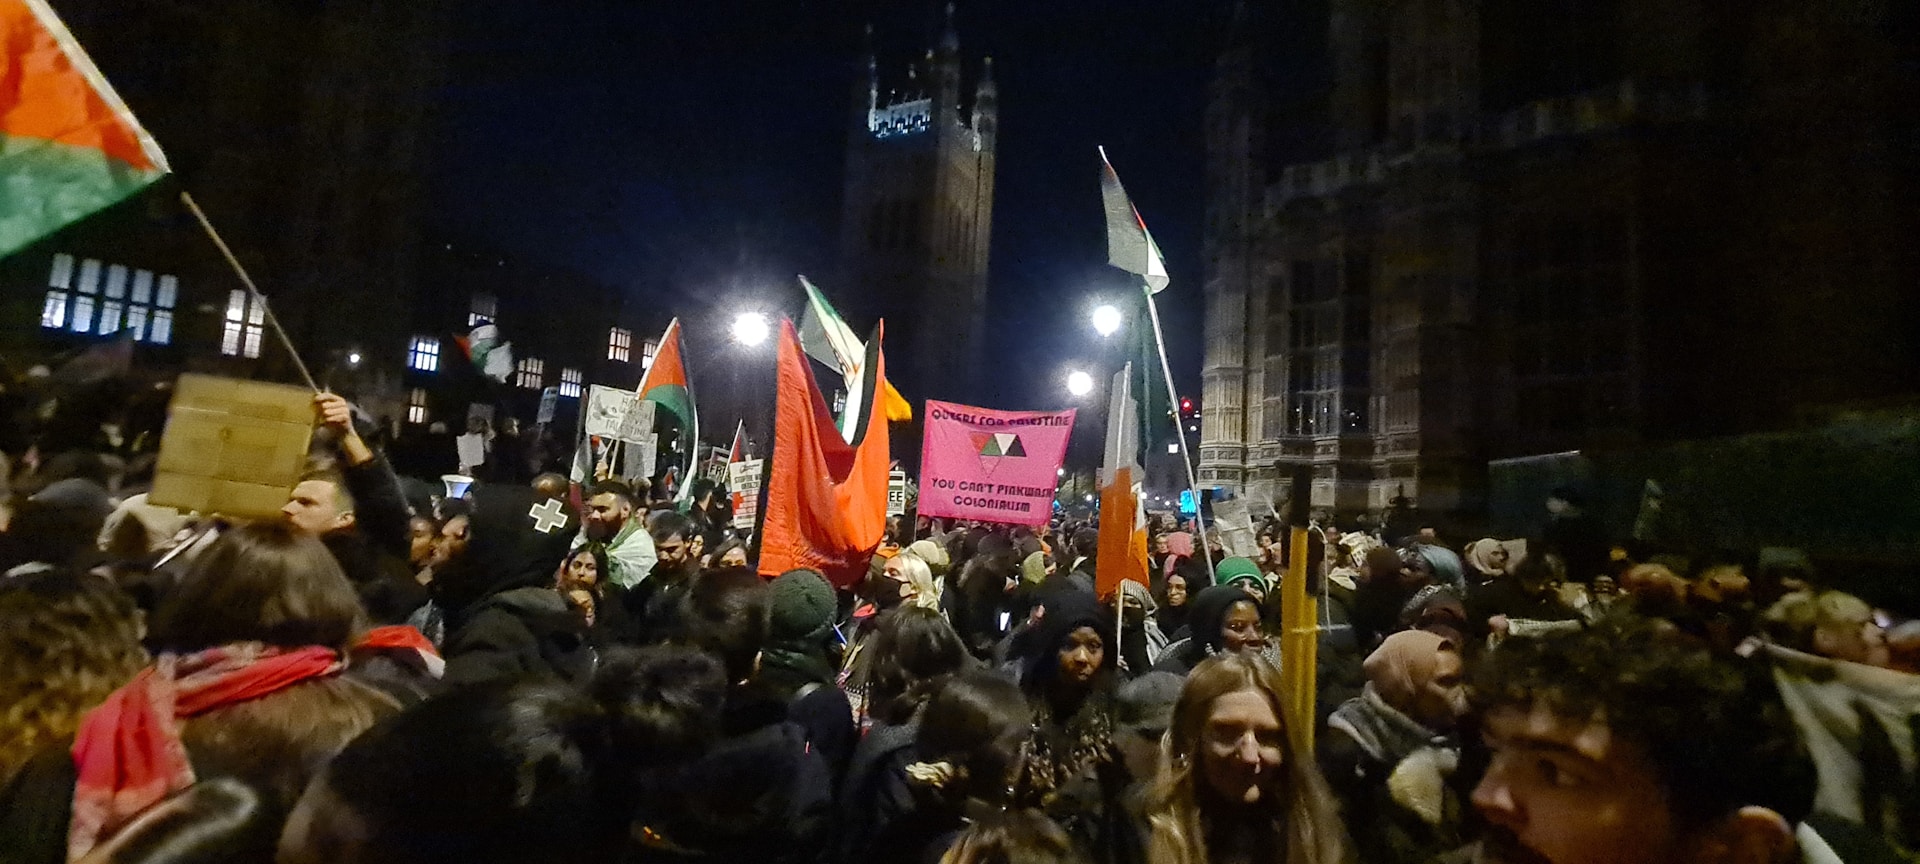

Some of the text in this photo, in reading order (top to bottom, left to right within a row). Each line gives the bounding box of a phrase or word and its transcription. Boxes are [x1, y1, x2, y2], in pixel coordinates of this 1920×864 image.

[931, 409, 1071, 427] QUEERS FOR PALESTINE
[931, 478, 955, 489] YOU
[958, 480, 995, 493] CAN'T
[953, 495, 1031, 512] COLONIALISM
